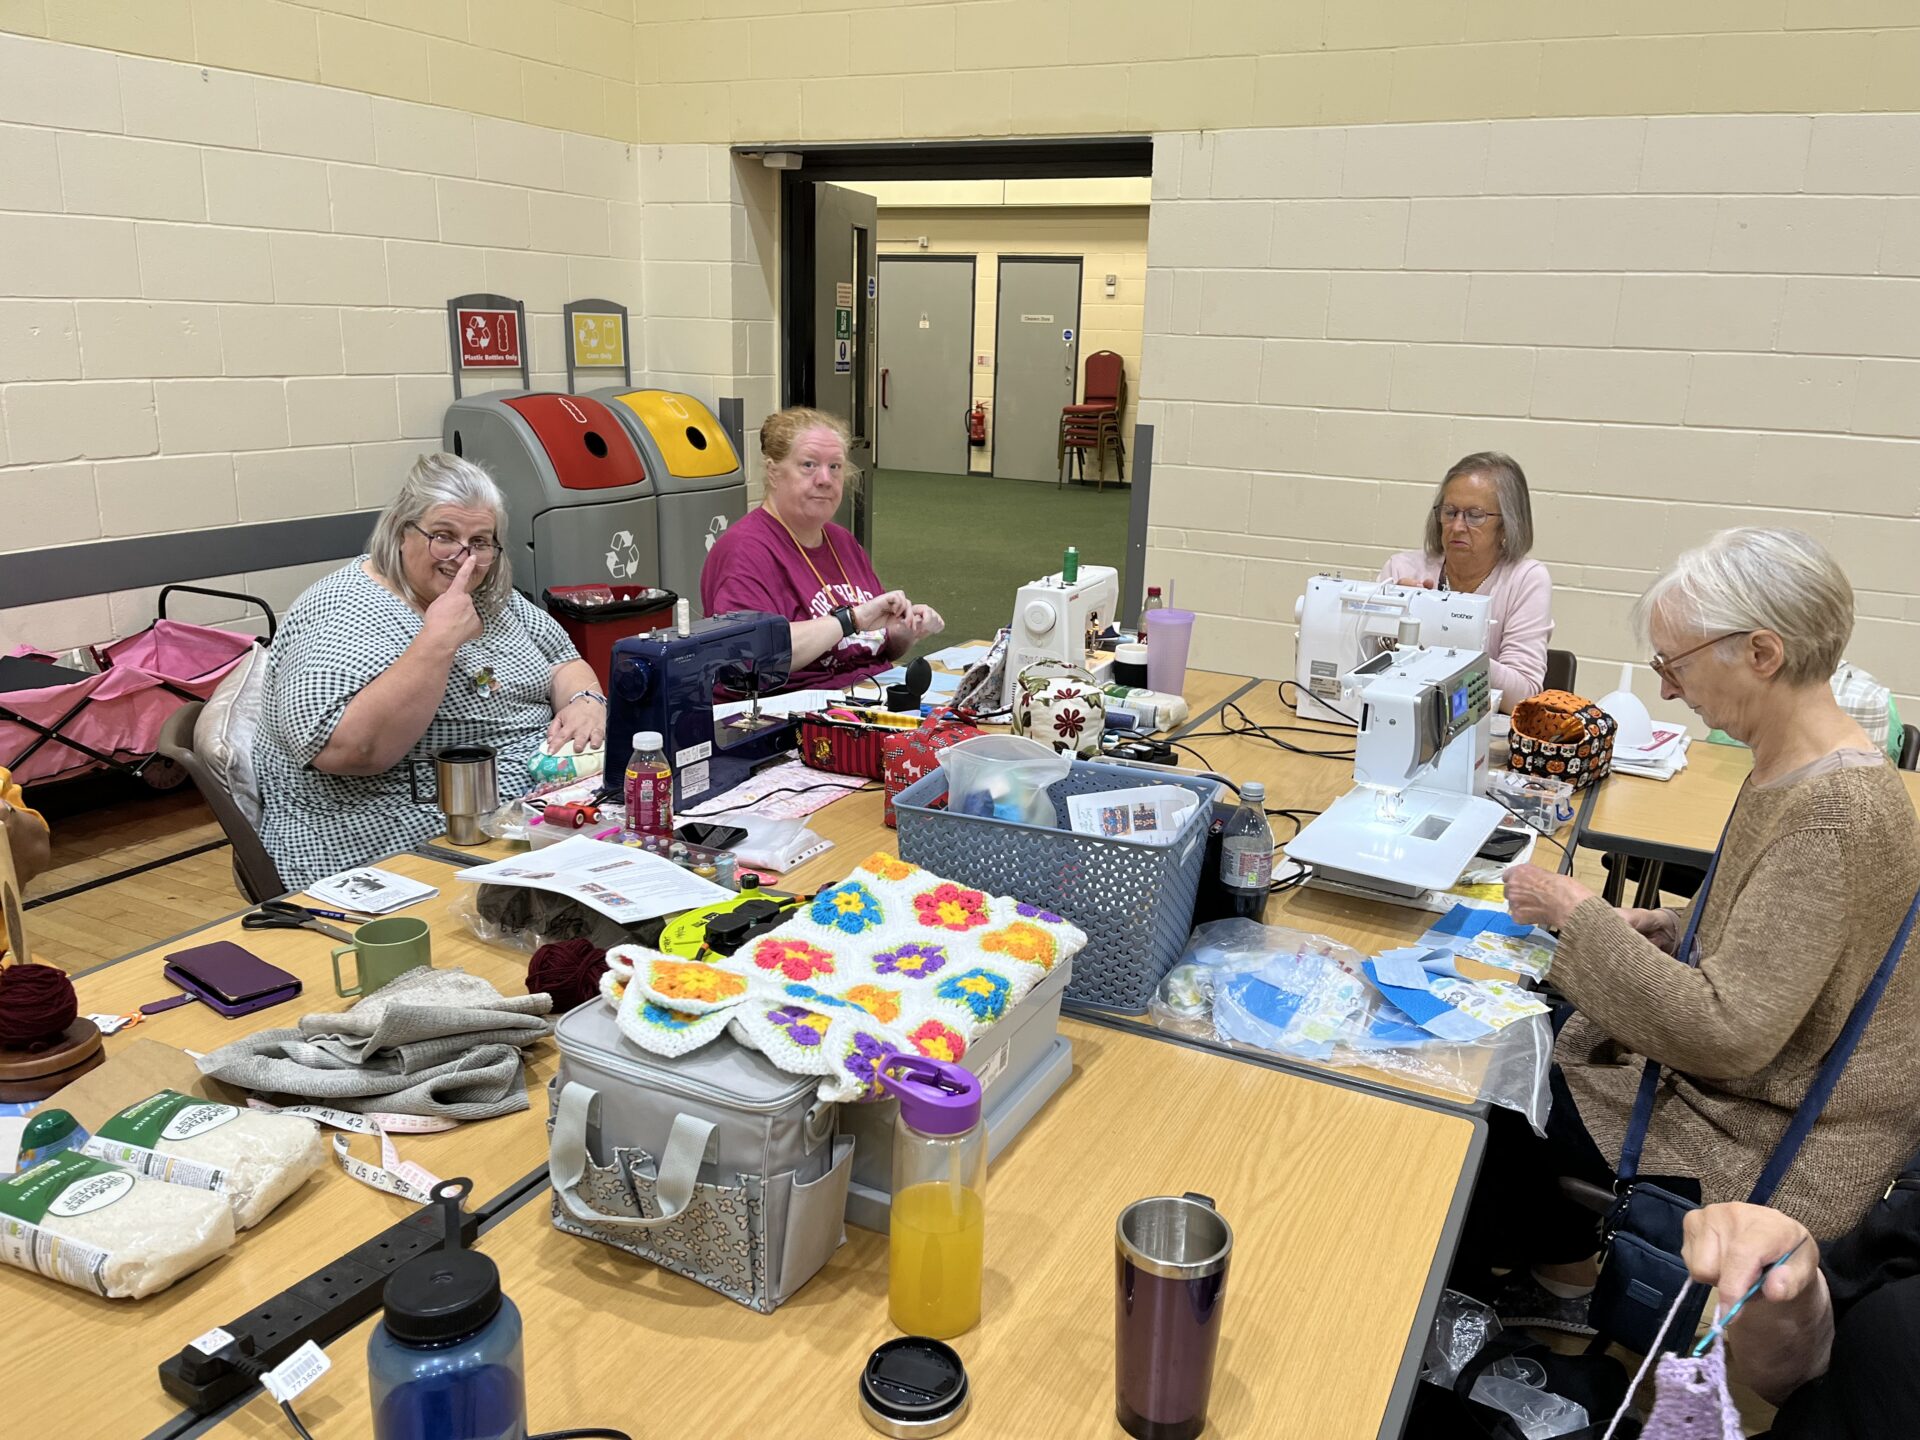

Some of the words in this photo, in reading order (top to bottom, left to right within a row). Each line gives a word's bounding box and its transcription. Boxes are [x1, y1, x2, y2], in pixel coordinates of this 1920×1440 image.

[505, 354, 518, 362] Only
[132, 1116, 151, 1131] RICE
[320, 1110, 335, 1120] 41
[346, 1117, 363, 1128] 42
[66, 1160, 91, 1171] LONG
[39, 1170, 67, 1186] GRAIN
[355, 1165, 367, 1178] 57
[371, 1171, 387, 1185] 56
[393, 1179, 411, 1193] 55
[18, 1186, 39, 1201] RICE
[63, 1175, 115, 1207] HARVEST
[67, 1176, 125, 1211] GROWER'S
